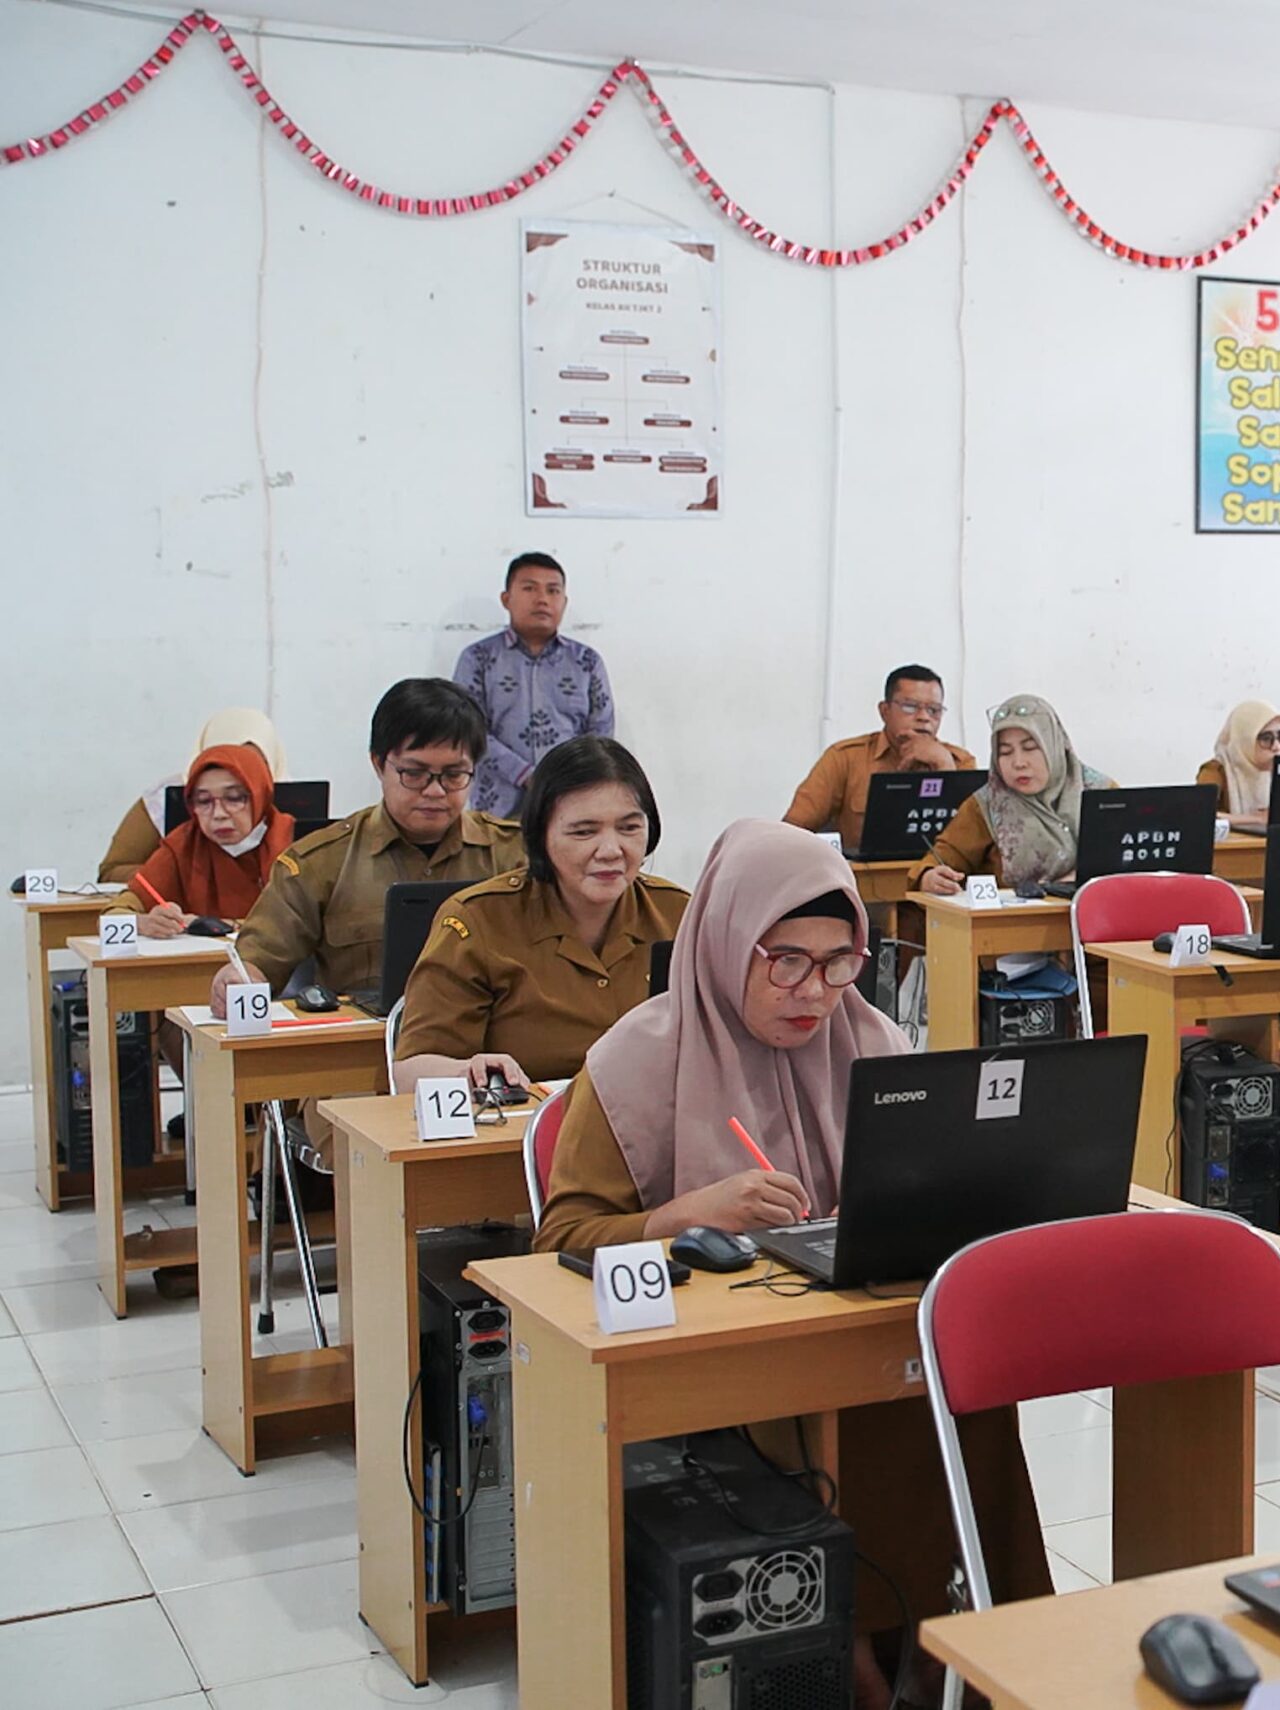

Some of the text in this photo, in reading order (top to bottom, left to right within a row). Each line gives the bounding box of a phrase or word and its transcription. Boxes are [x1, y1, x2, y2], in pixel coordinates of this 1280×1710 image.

[582, 259, 661, 275] STRUKTUR
[576, 277, 668, 293] ORGANISASI
[924, 783, 938, 793] 21
[906, 822, 944, 834] 201
[1121, 831, 1181, 844] APBN
[1122, 847, 1176, 862] 2015
[28, 876, 56, 893] 29
[973, 883, 997, 900] 23
[104, 923, 136, 945] 22
[1186, 934, 1209, 955] 18
[234, 993, 269, 1020] 19
[874, 1090, 927, 1104] Lenovo
[986, 1077, 1017, 1101] 12
[428, 1089, 470, 1119] 12
[610, 1260, 666, 1303] 09
